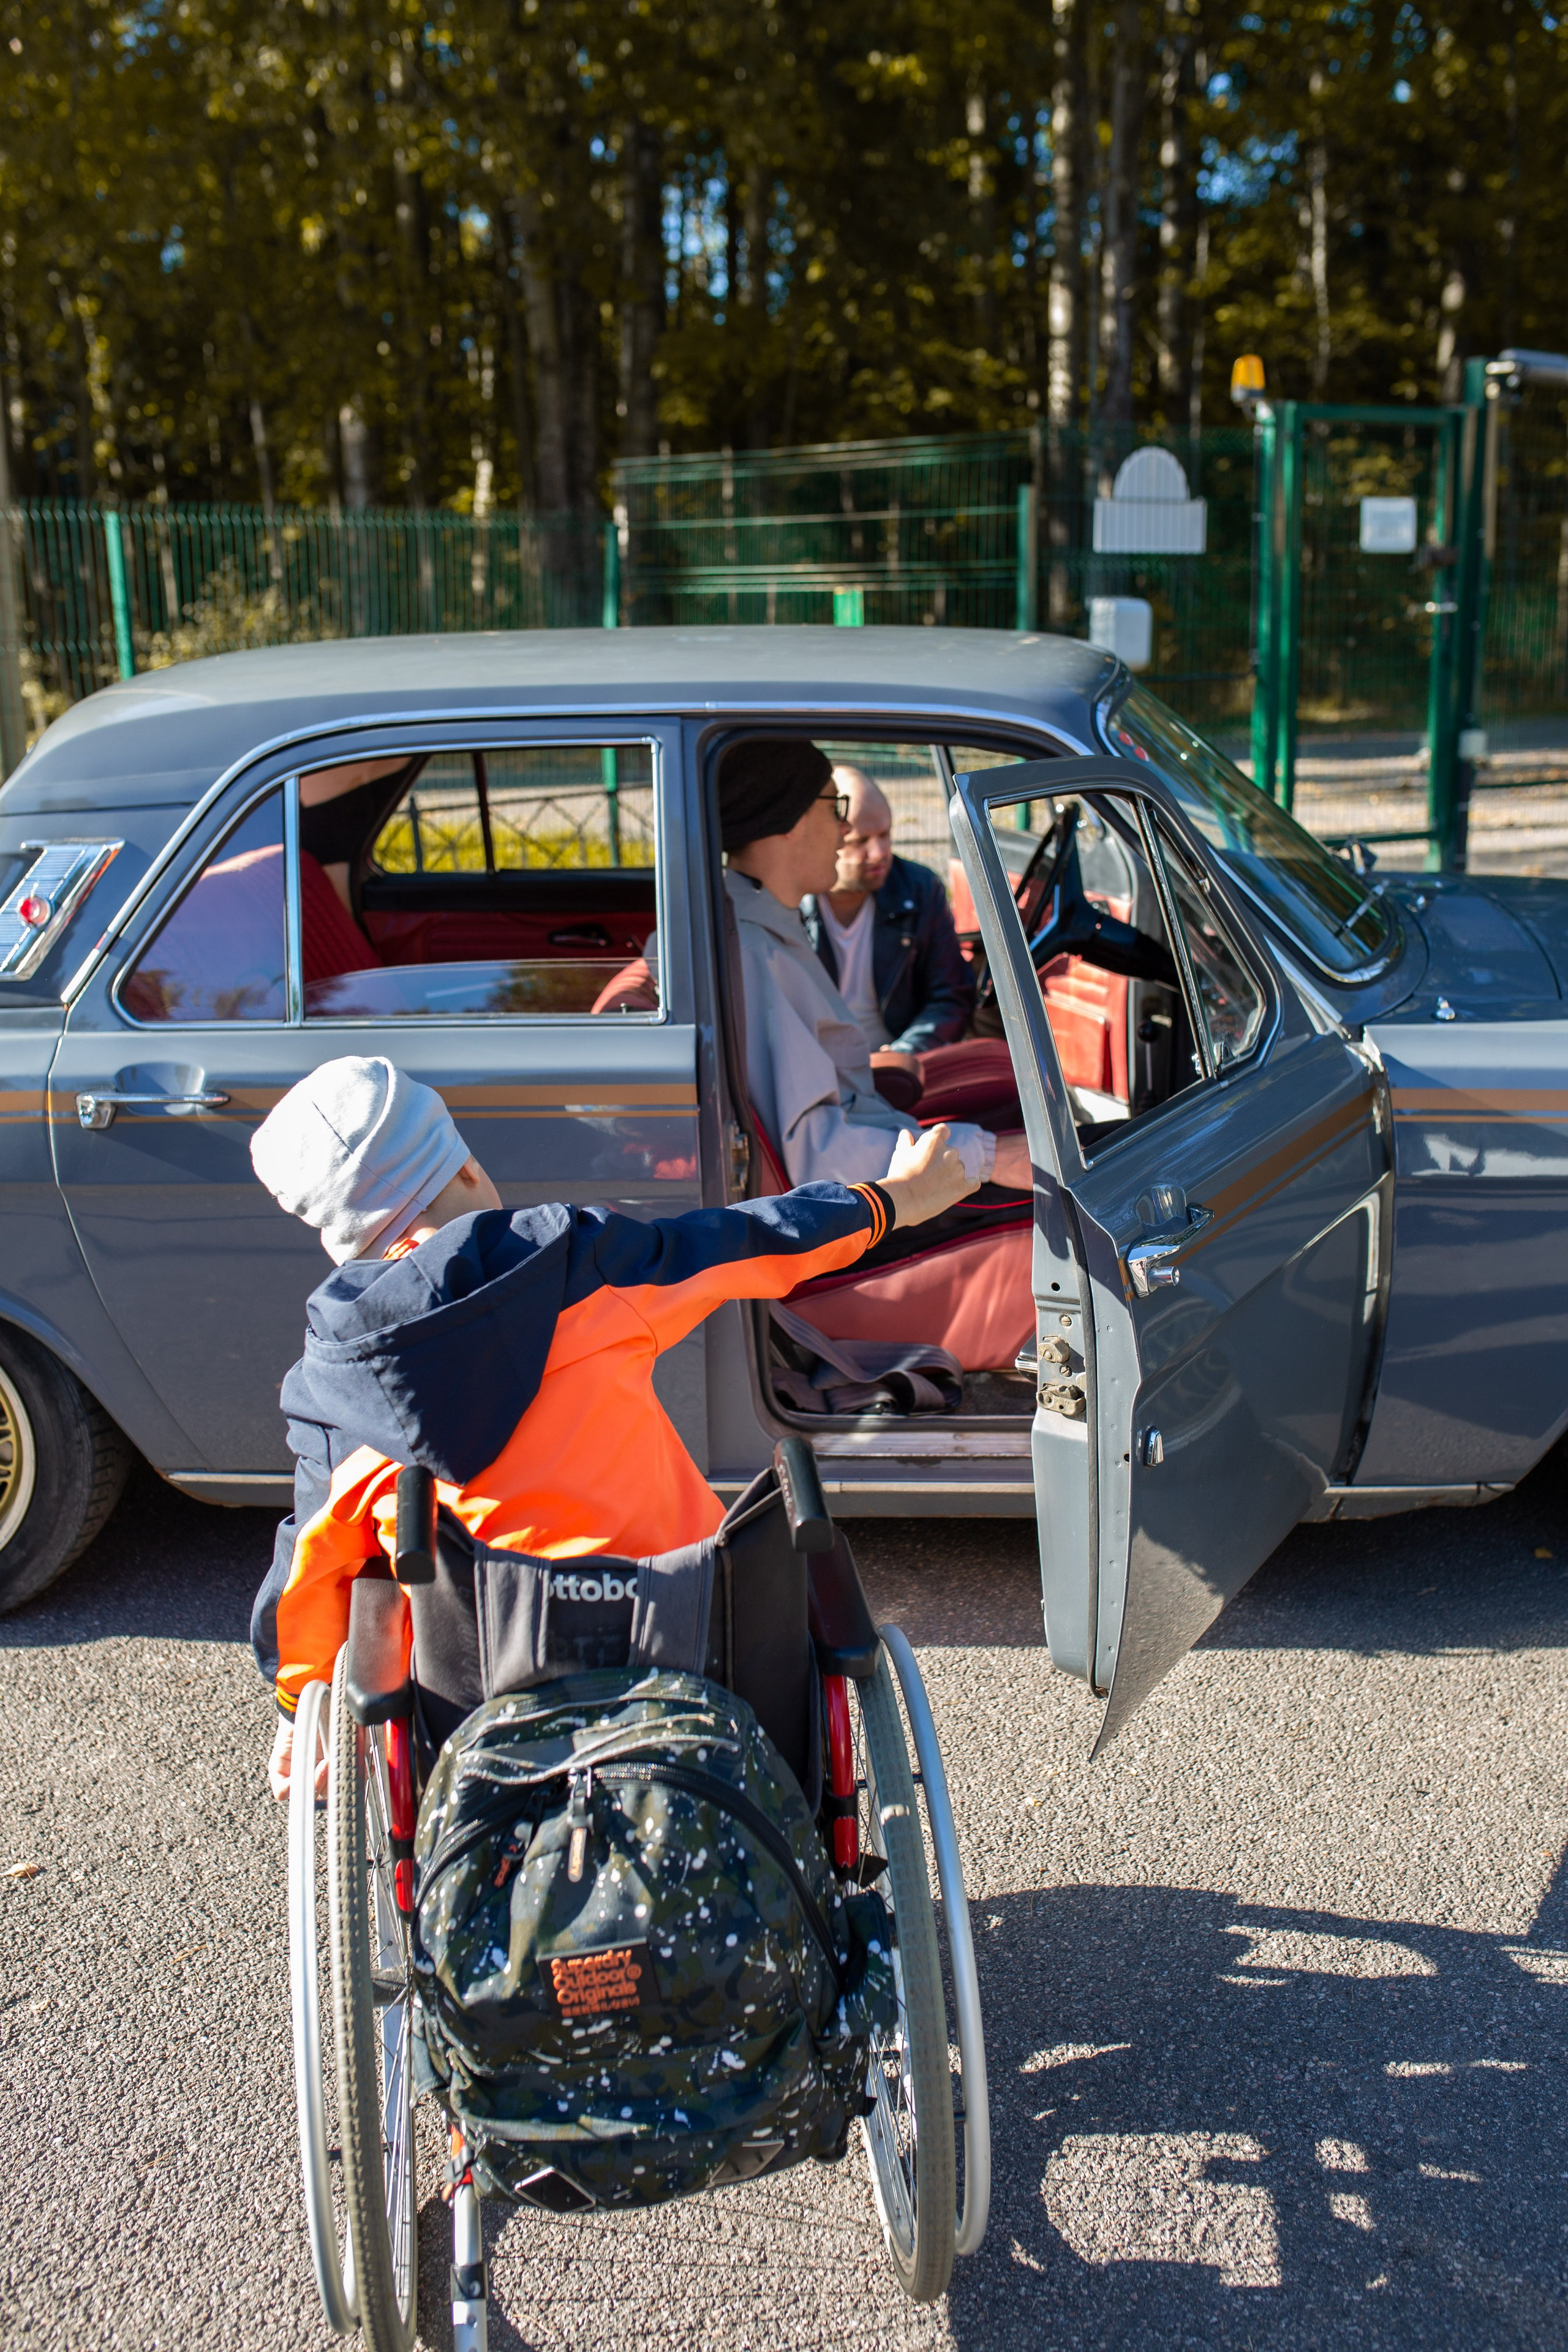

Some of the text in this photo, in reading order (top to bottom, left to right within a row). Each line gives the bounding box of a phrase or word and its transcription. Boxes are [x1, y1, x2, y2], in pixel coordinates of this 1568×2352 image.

[551, 1949, 632, 1977] Superdry
[553, 1969, 625, 1991] Outdoor
[557, 1981, 637, 2006] Originals
